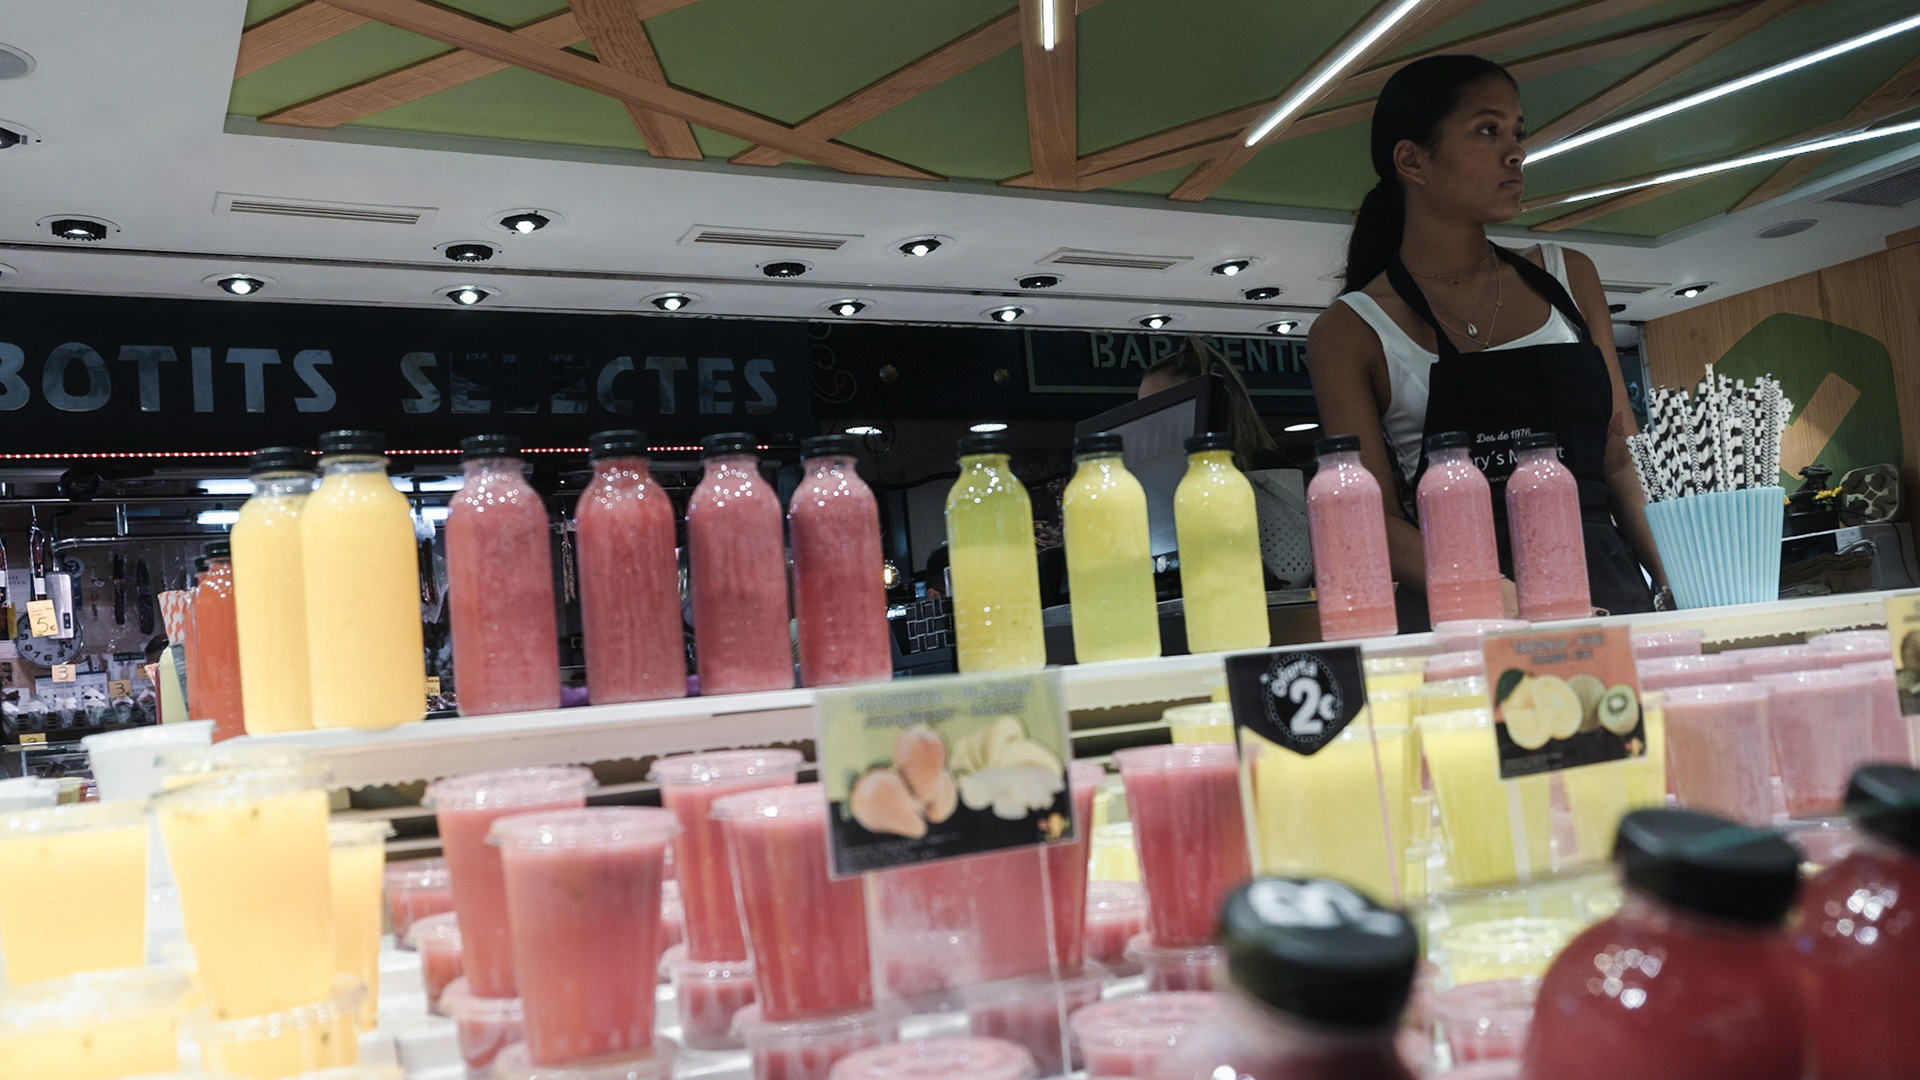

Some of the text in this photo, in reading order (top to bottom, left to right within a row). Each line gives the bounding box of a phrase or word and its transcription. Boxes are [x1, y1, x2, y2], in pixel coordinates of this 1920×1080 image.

[400, 351, 778, 415] SELECTES
[1476, 433, 1496, 443] Des
[1497, 431, 1509, 440] de
